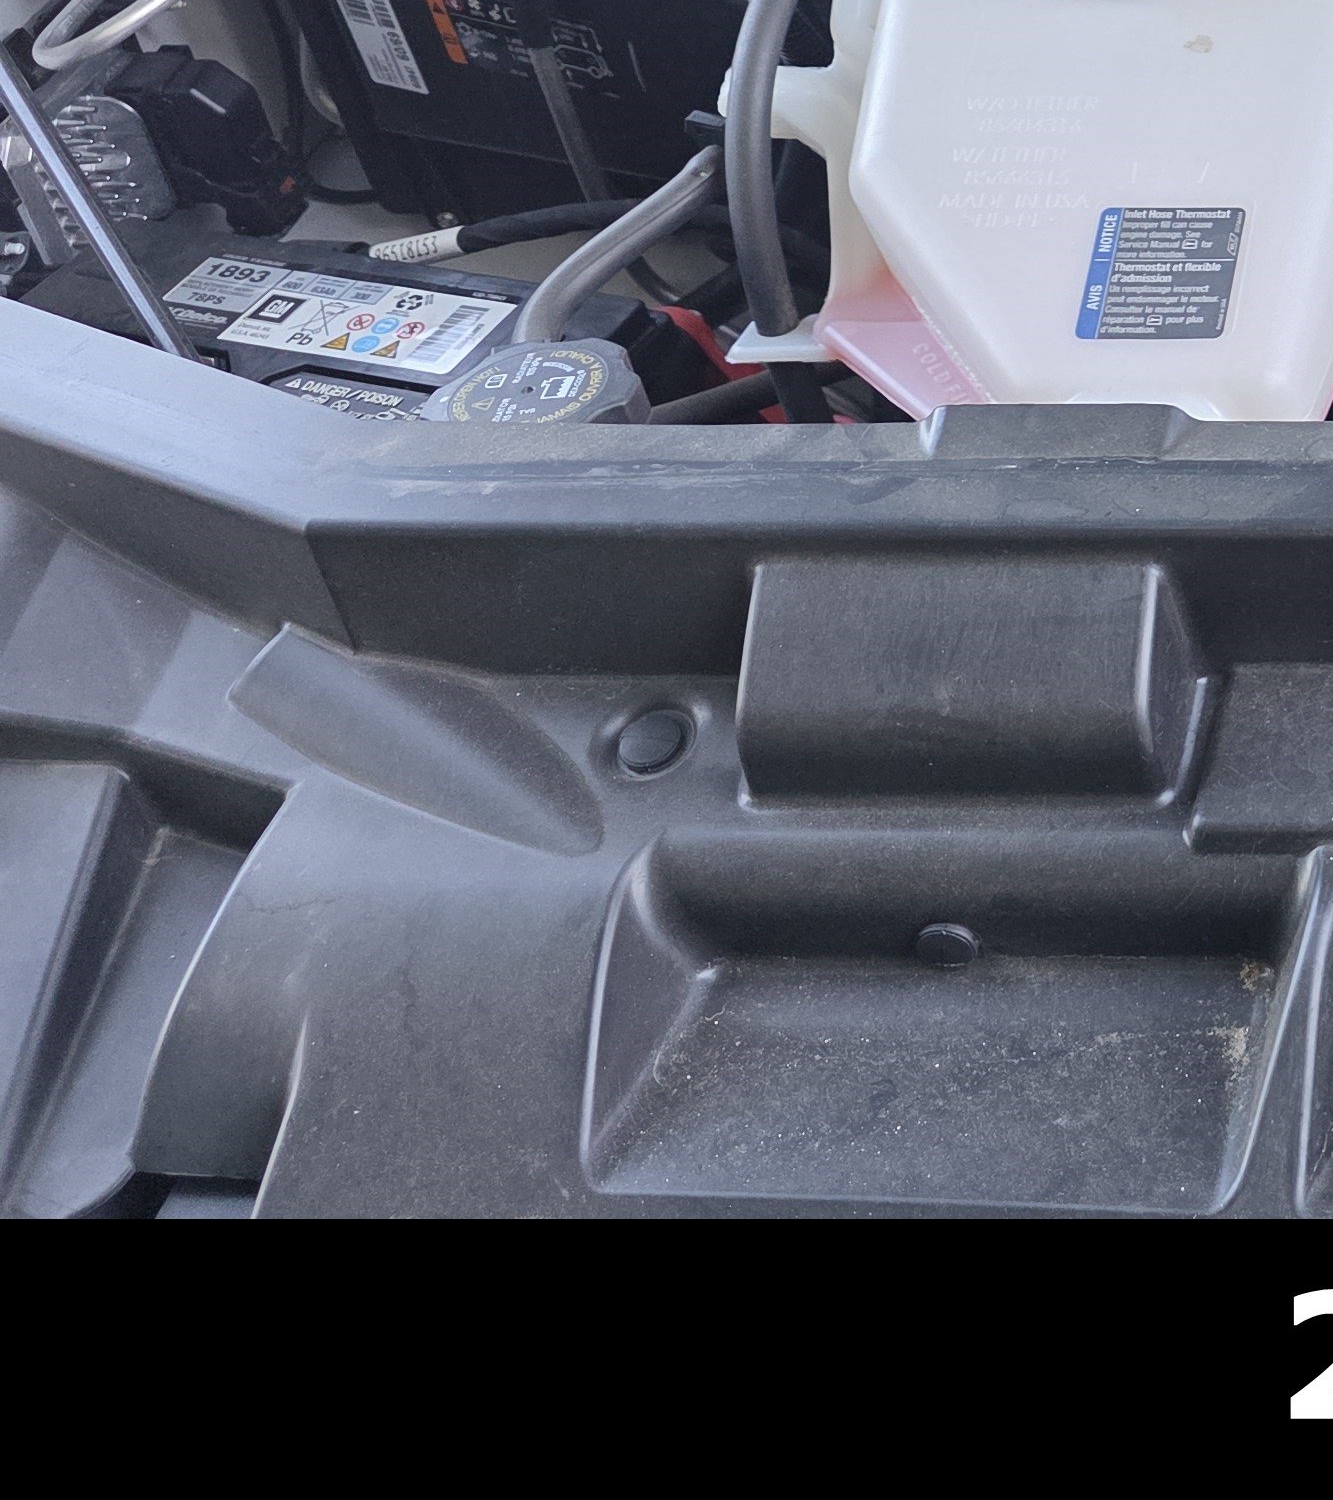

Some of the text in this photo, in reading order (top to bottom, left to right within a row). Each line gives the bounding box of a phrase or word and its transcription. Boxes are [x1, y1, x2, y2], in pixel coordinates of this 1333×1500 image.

[1046, 193, 1089, 209] USA
[1125, 210, 1231, 219] Inlet Hose Thermostat
[1098, 214, 1118, 252] NOTICE
[207, 263, 271, 282] 1893
[1114, 263, 1221, 272] Thermostat et flexible
[1111, 274, 1172, 282] d'admission
[187, 292, 227, 304] 78PS
[1086, 285, 1103, 310] AVIS
[259, 299, 295, 318] GM
[285, 333, 313, 345] Pb
[912, 342, 951, 384] COLD
